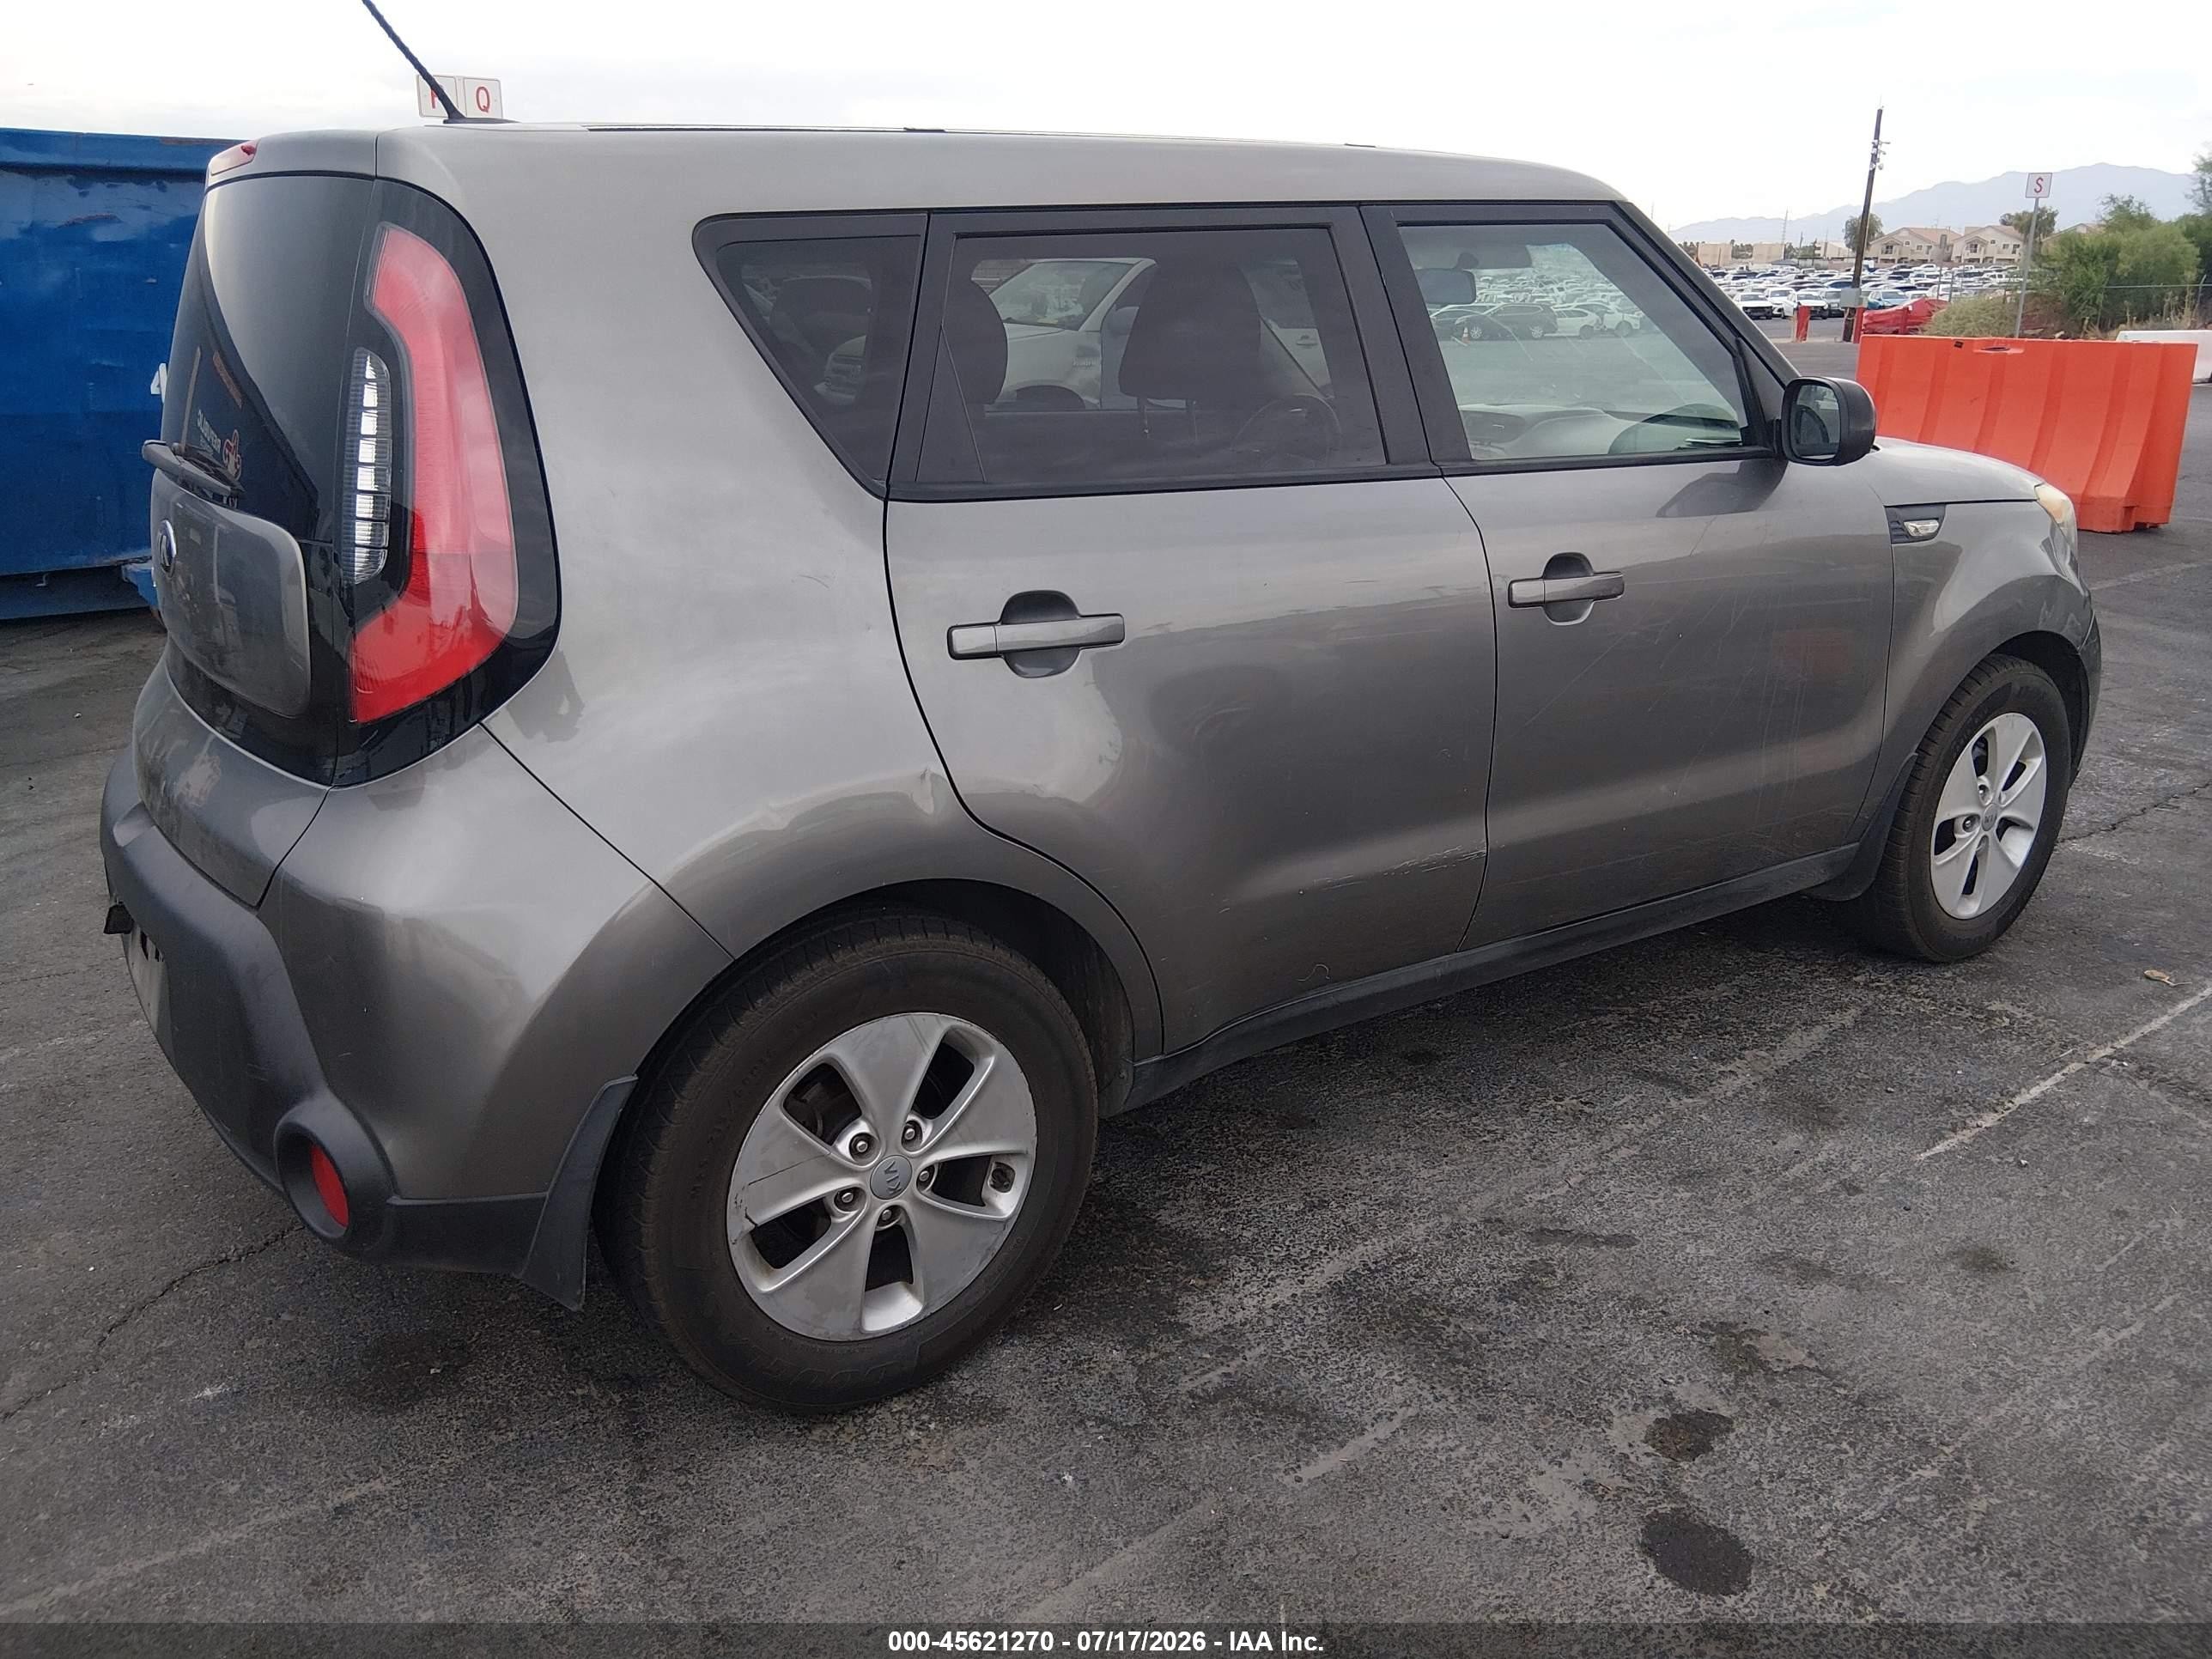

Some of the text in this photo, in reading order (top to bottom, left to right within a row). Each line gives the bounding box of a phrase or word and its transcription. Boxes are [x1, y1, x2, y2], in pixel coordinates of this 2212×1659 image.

[476, 86, 491, 113] Q
[2033, 177, 2044, 193] S
[884, 1160, 902, 1195] KIA
